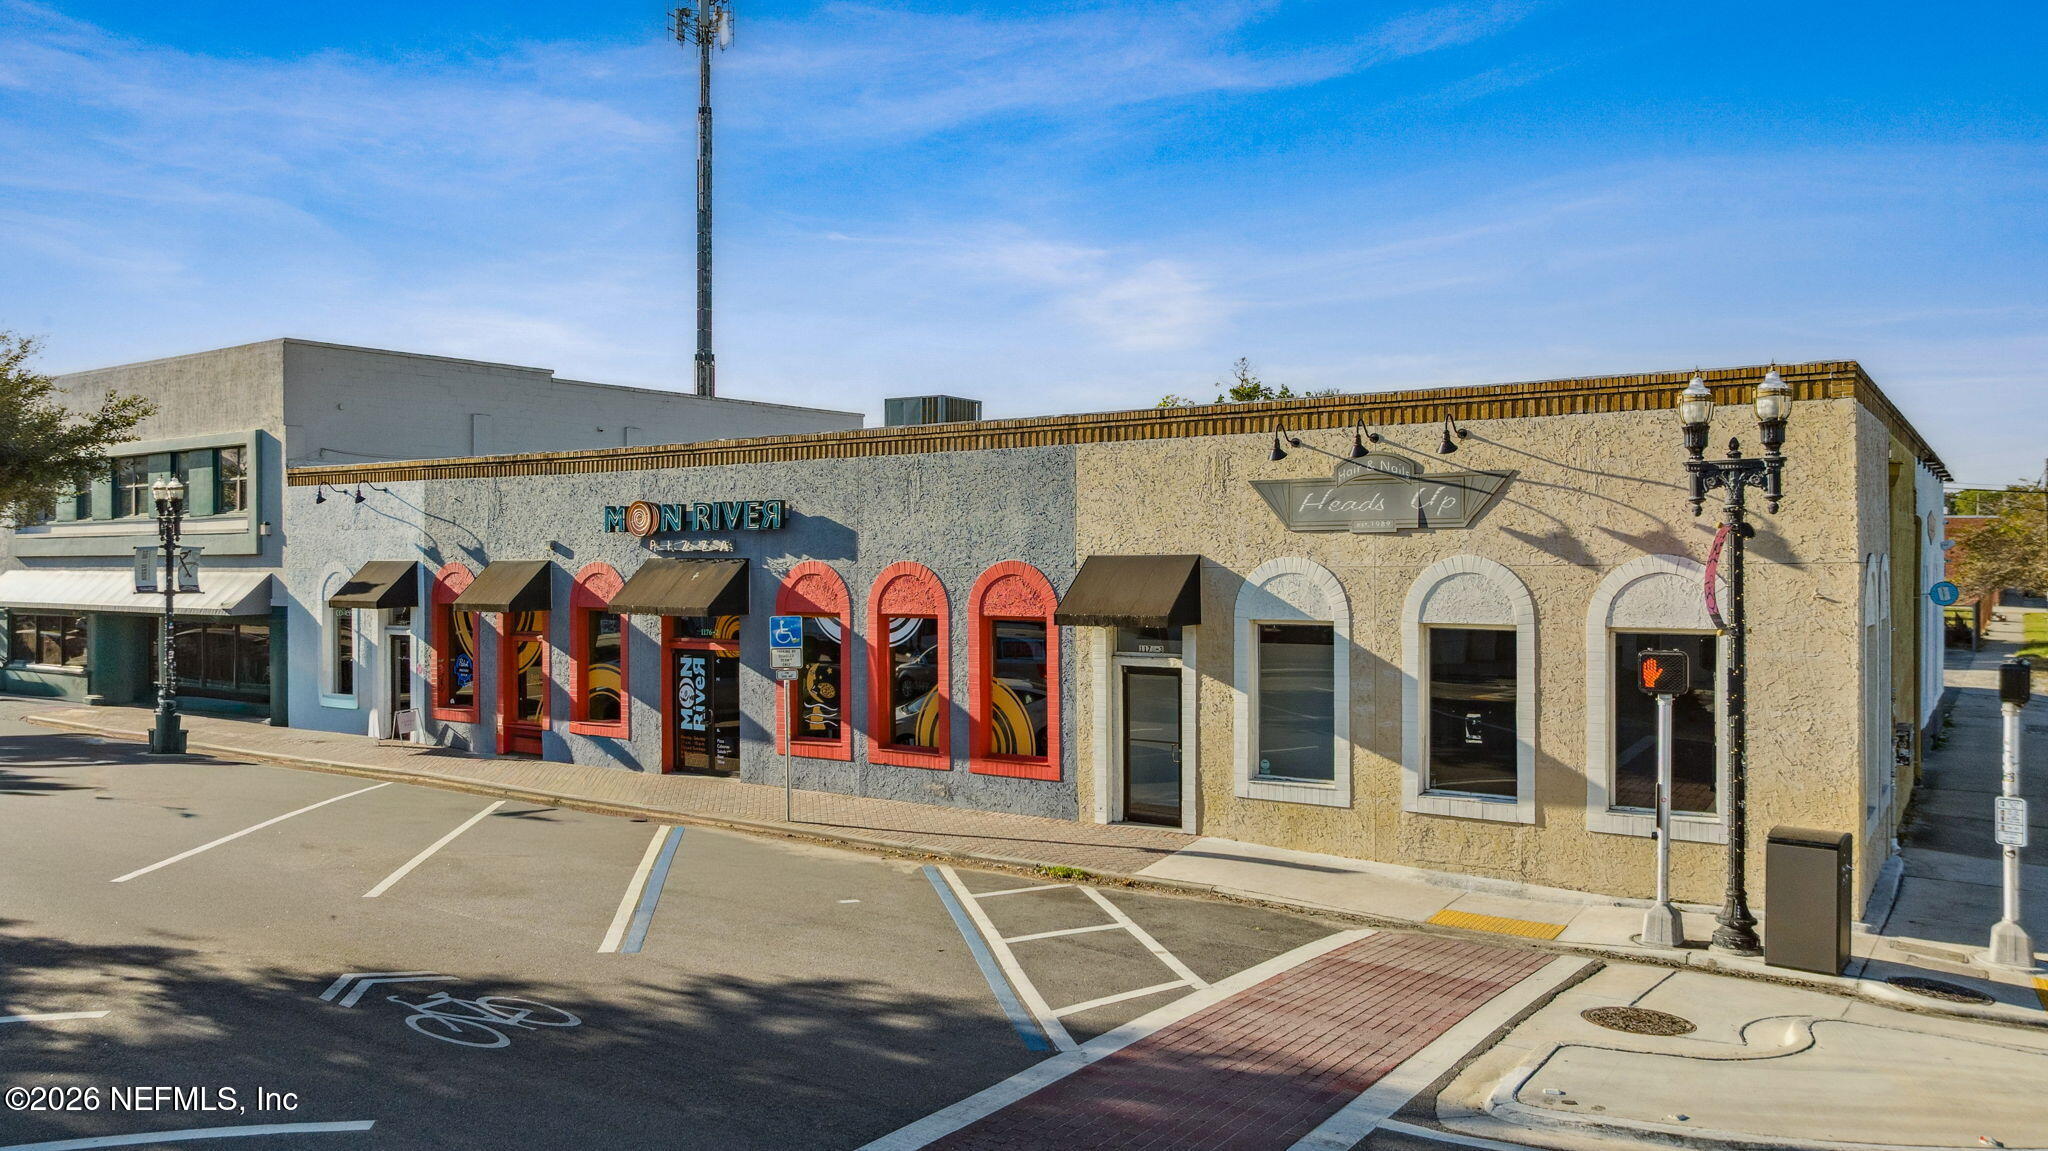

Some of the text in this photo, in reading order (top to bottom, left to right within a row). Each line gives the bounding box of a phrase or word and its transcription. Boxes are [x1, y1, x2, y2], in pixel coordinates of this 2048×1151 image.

[1338, 459, 1411, 480] Hair & Nails
[1298, 486, 1457, 516] Heads Up
[693, 500, 785, 531] RIVER
[650, 539, 733, 553] PIZZA
